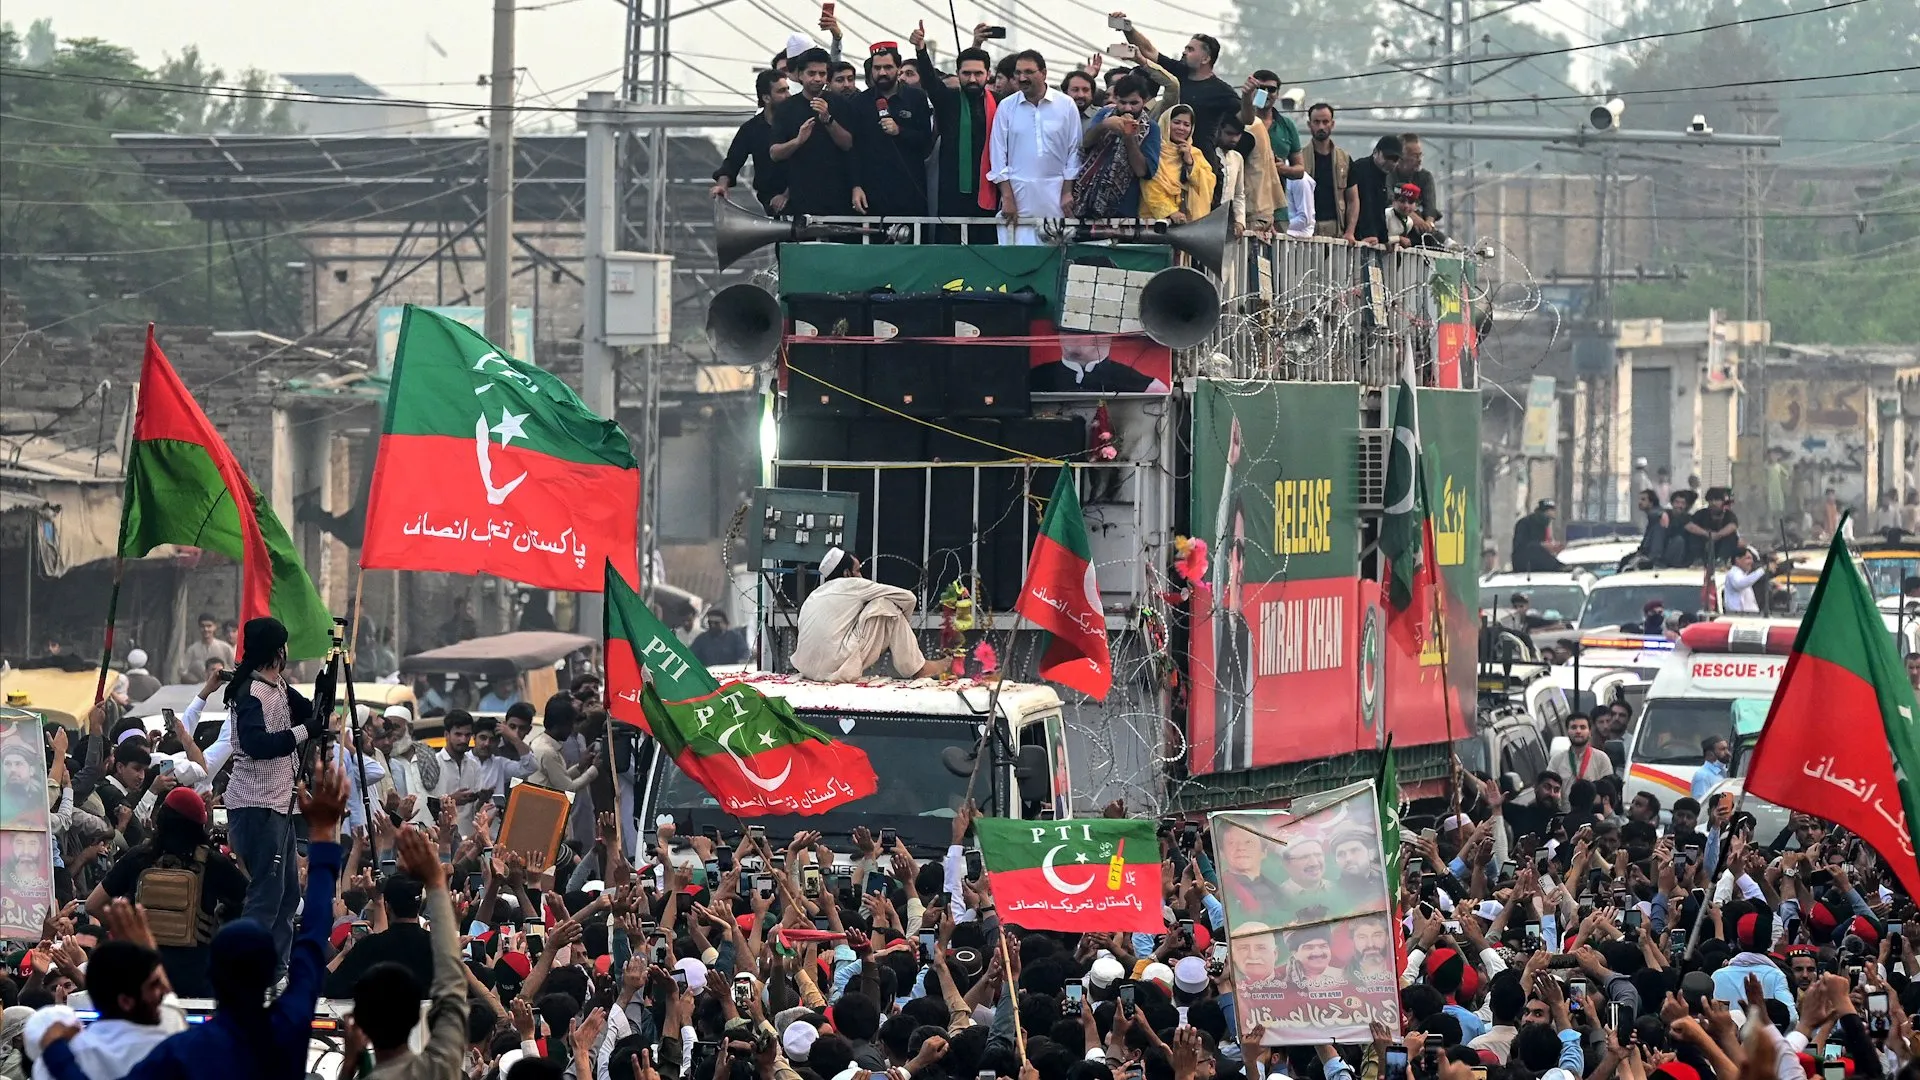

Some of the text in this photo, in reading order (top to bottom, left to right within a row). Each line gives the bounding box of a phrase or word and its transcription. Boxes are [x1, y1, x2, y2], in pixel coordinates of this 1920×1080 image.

[1274, 478, 1332, 555] RELEASE
[513, 526, 586, 569] پاکستان
[1259, 599, 1304, 676] IMRAN
[1307, 596, 1343, 671] KHAN
[640, 635, 691, 683] PTI
[1692, 664, 1785, 679] RESCUE-11
[694, 690, 749, 731] PT
[801, 776, 854, 809] پاکستان
[1803, 756, 1877, 803] انصاف
[1031, 824, 1093, 844] PTI
[1111, 862, 1122, 882] PTI
[1008, 894, 1143, 913] پاکستان تحریک انصاف
